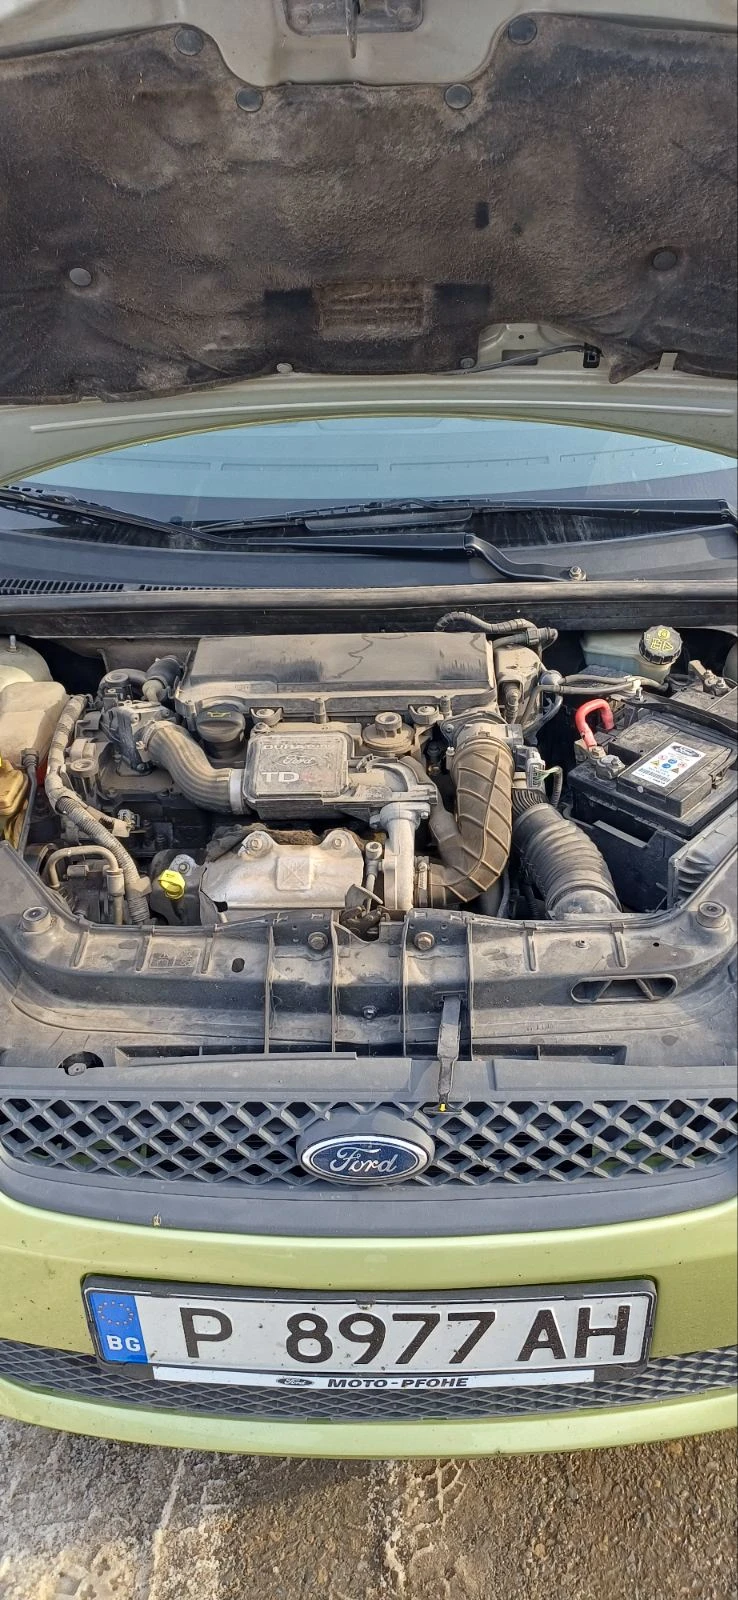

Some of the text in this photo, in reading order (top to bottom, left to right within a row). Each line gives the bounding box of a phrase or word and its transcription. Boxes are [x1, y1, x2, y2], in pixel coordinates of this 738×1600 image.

[329, 1146, 399, 1173] Ford
[106, 1334, 142, 1352] BG
[179, 1304, 631, 1365] P 8977 AH
